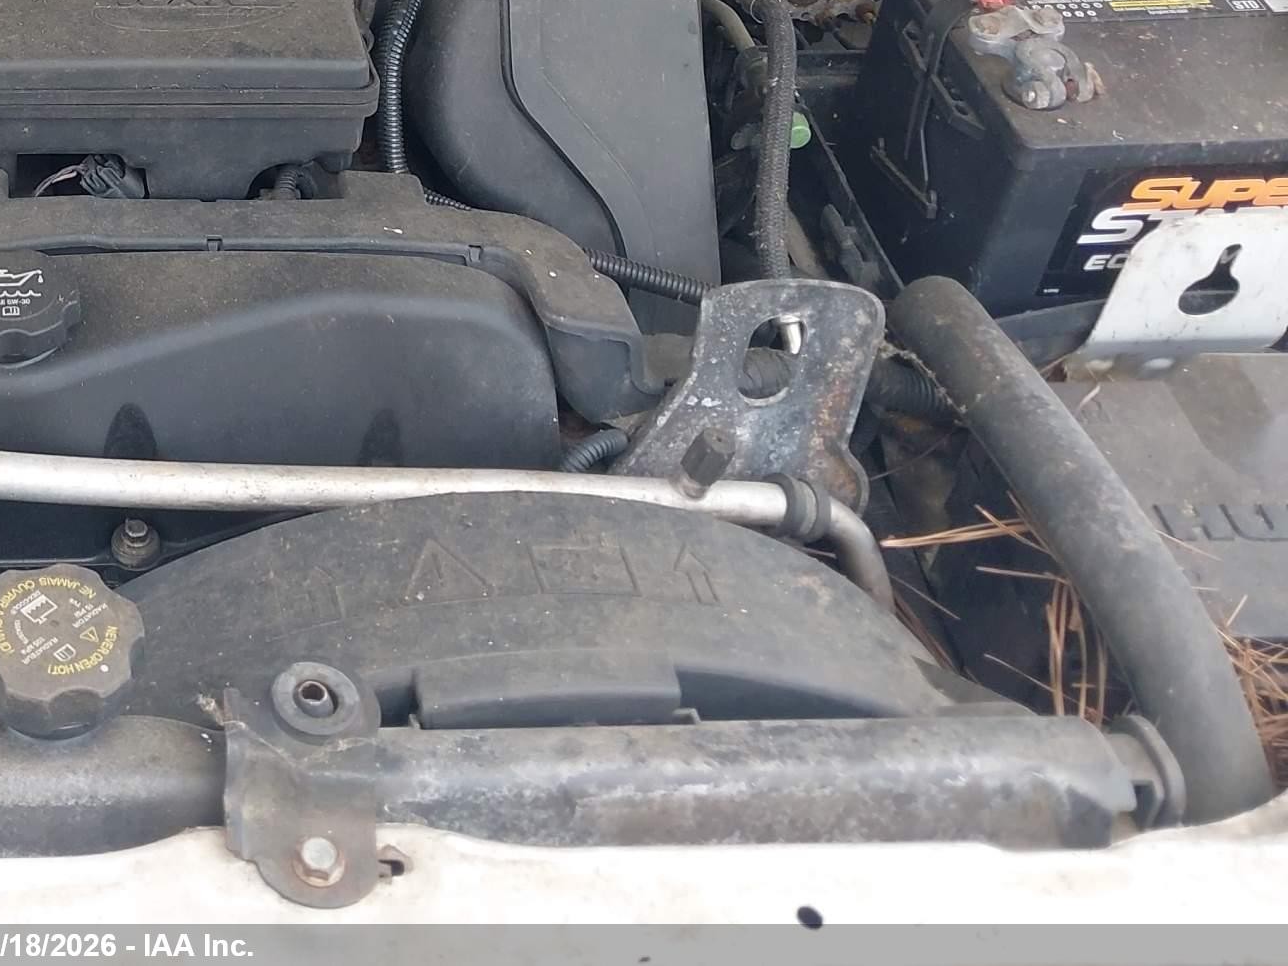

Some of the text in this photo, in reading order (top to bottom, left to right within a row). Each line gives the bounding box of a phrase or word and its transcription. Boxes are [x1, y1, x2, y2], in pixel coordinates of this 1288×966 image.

[1232, 0, 1260, 9] STD
[38, 576, 81, 590] JAMAIS
[78, 585, 97, 600] NE
[47, 625, 119, 675] NEVER OPEN HOT!
